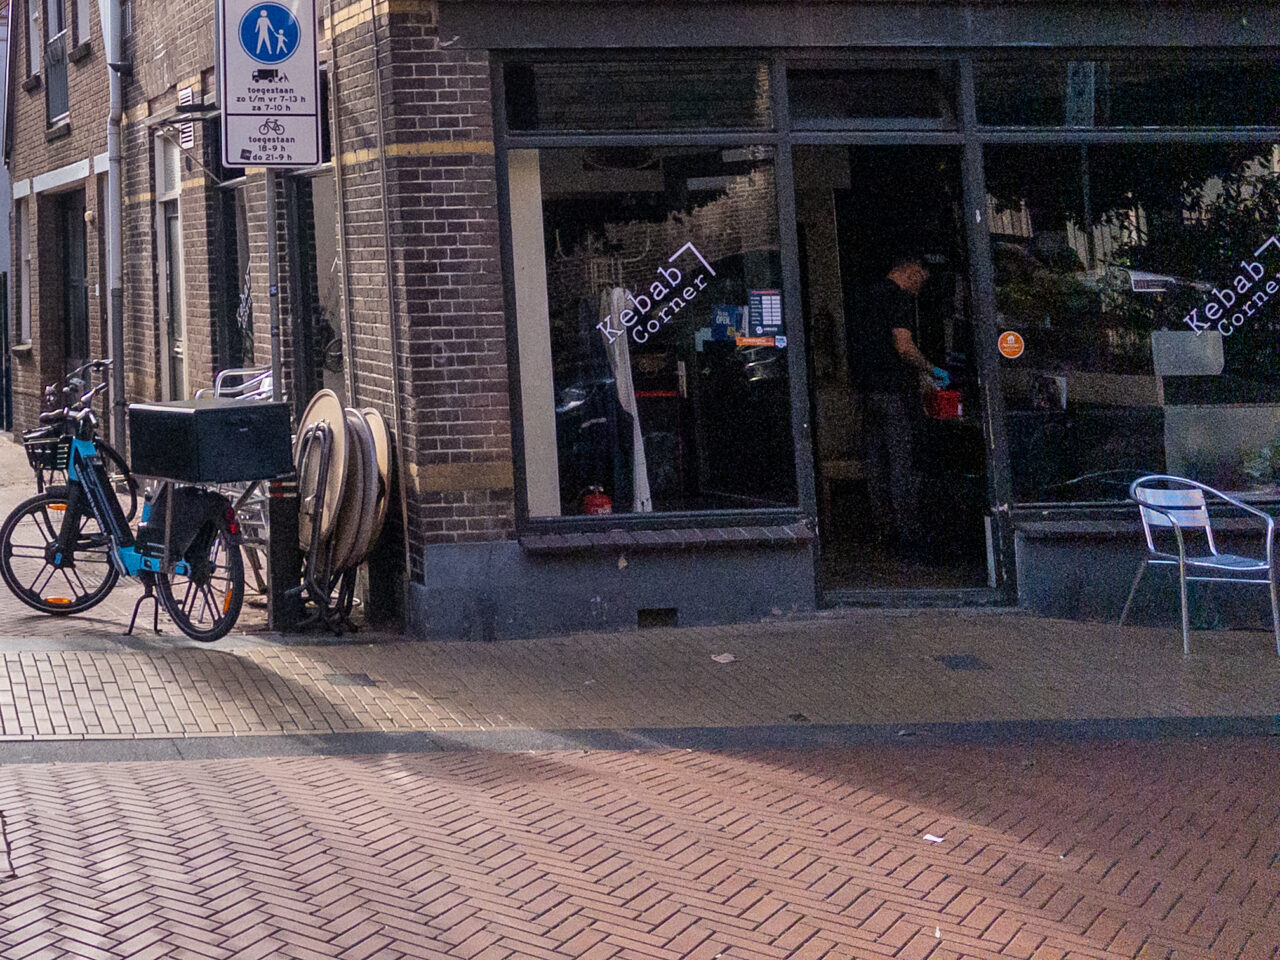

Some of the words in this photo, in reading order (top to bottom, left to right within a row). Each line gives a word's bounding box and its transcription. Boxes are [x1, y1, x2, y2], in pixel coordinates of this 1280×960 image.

[247, 87, 294, 95] toegestaan
[280, 95, 298, 103] 7-13
[248, 136, 295, 144] toegestaan
[596, 266, 682, 344] Kebab
[632, 274, 707, 343] Corner
[1183, 260, 1264, 336] Kebab
